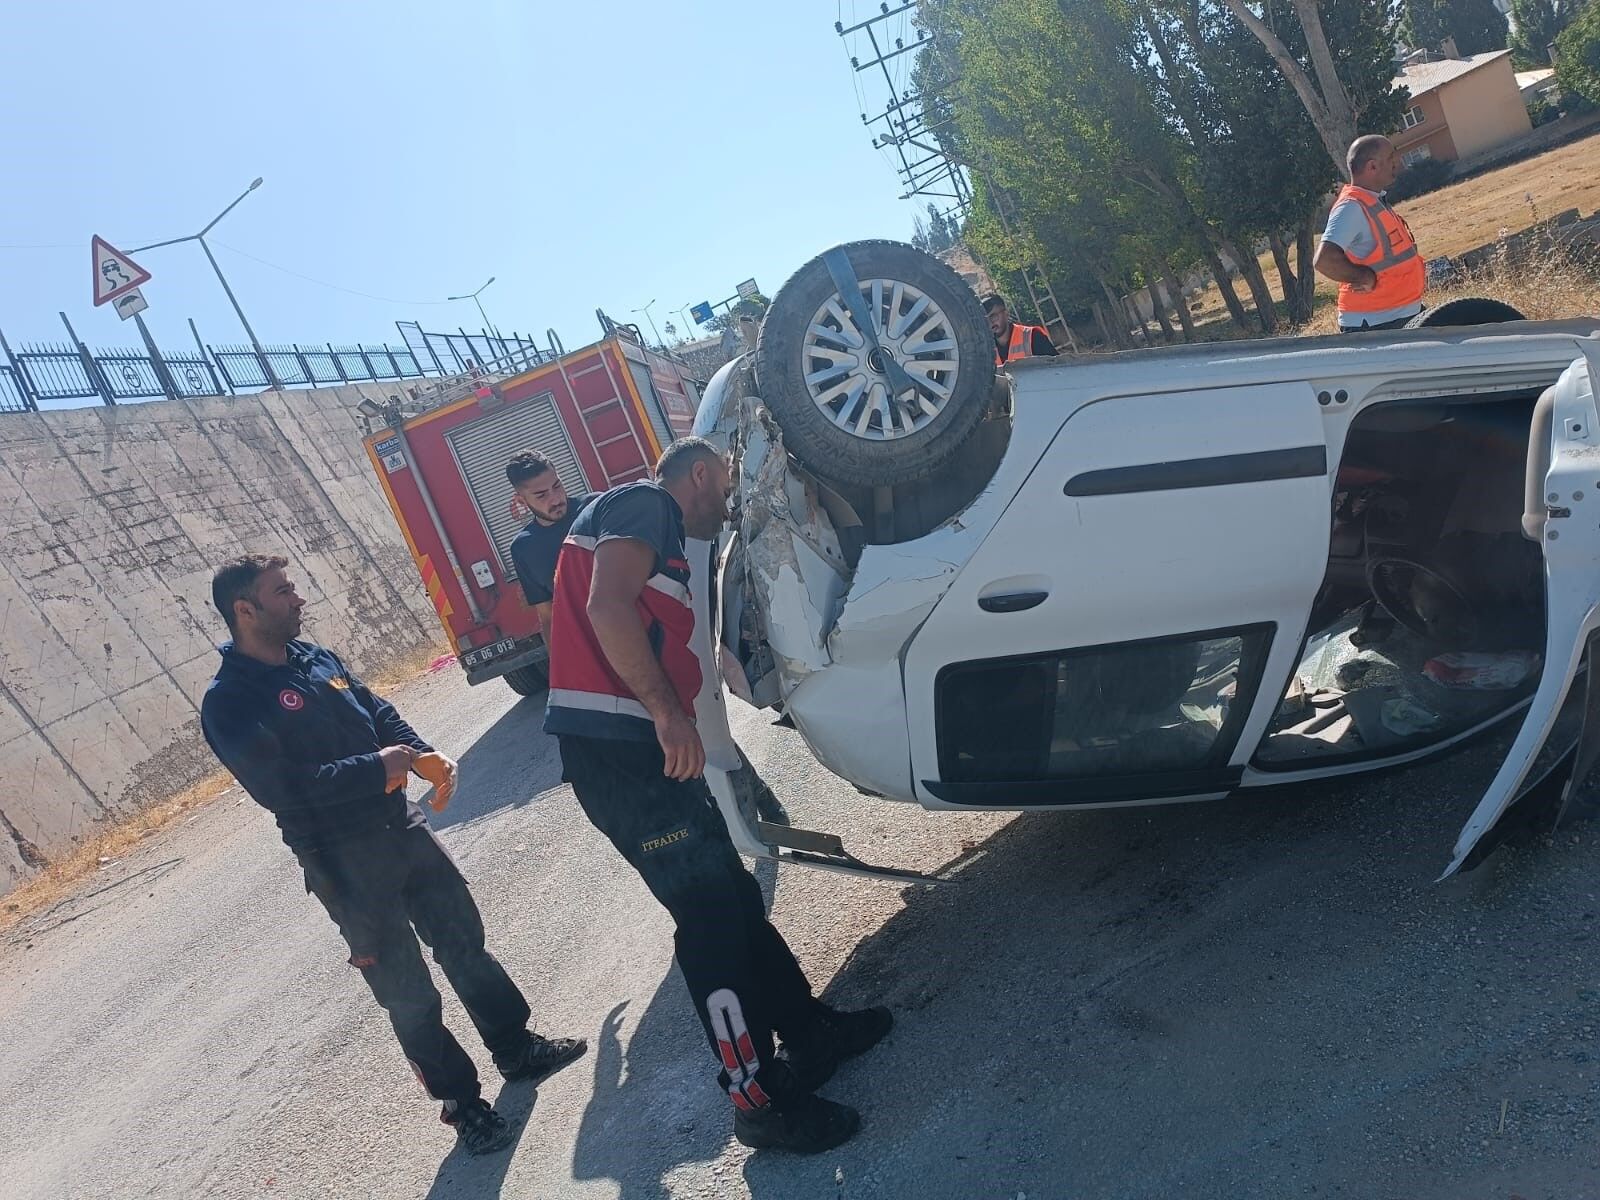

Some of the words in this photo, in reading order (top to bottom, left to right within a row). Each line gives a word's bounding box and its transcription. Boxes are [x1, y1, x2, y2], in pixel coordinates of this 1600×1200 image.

[465, 654, 477, 666] 65
[496, 640, 513, 653] 013
[641, 828, 688, 851] İTFAİYE
